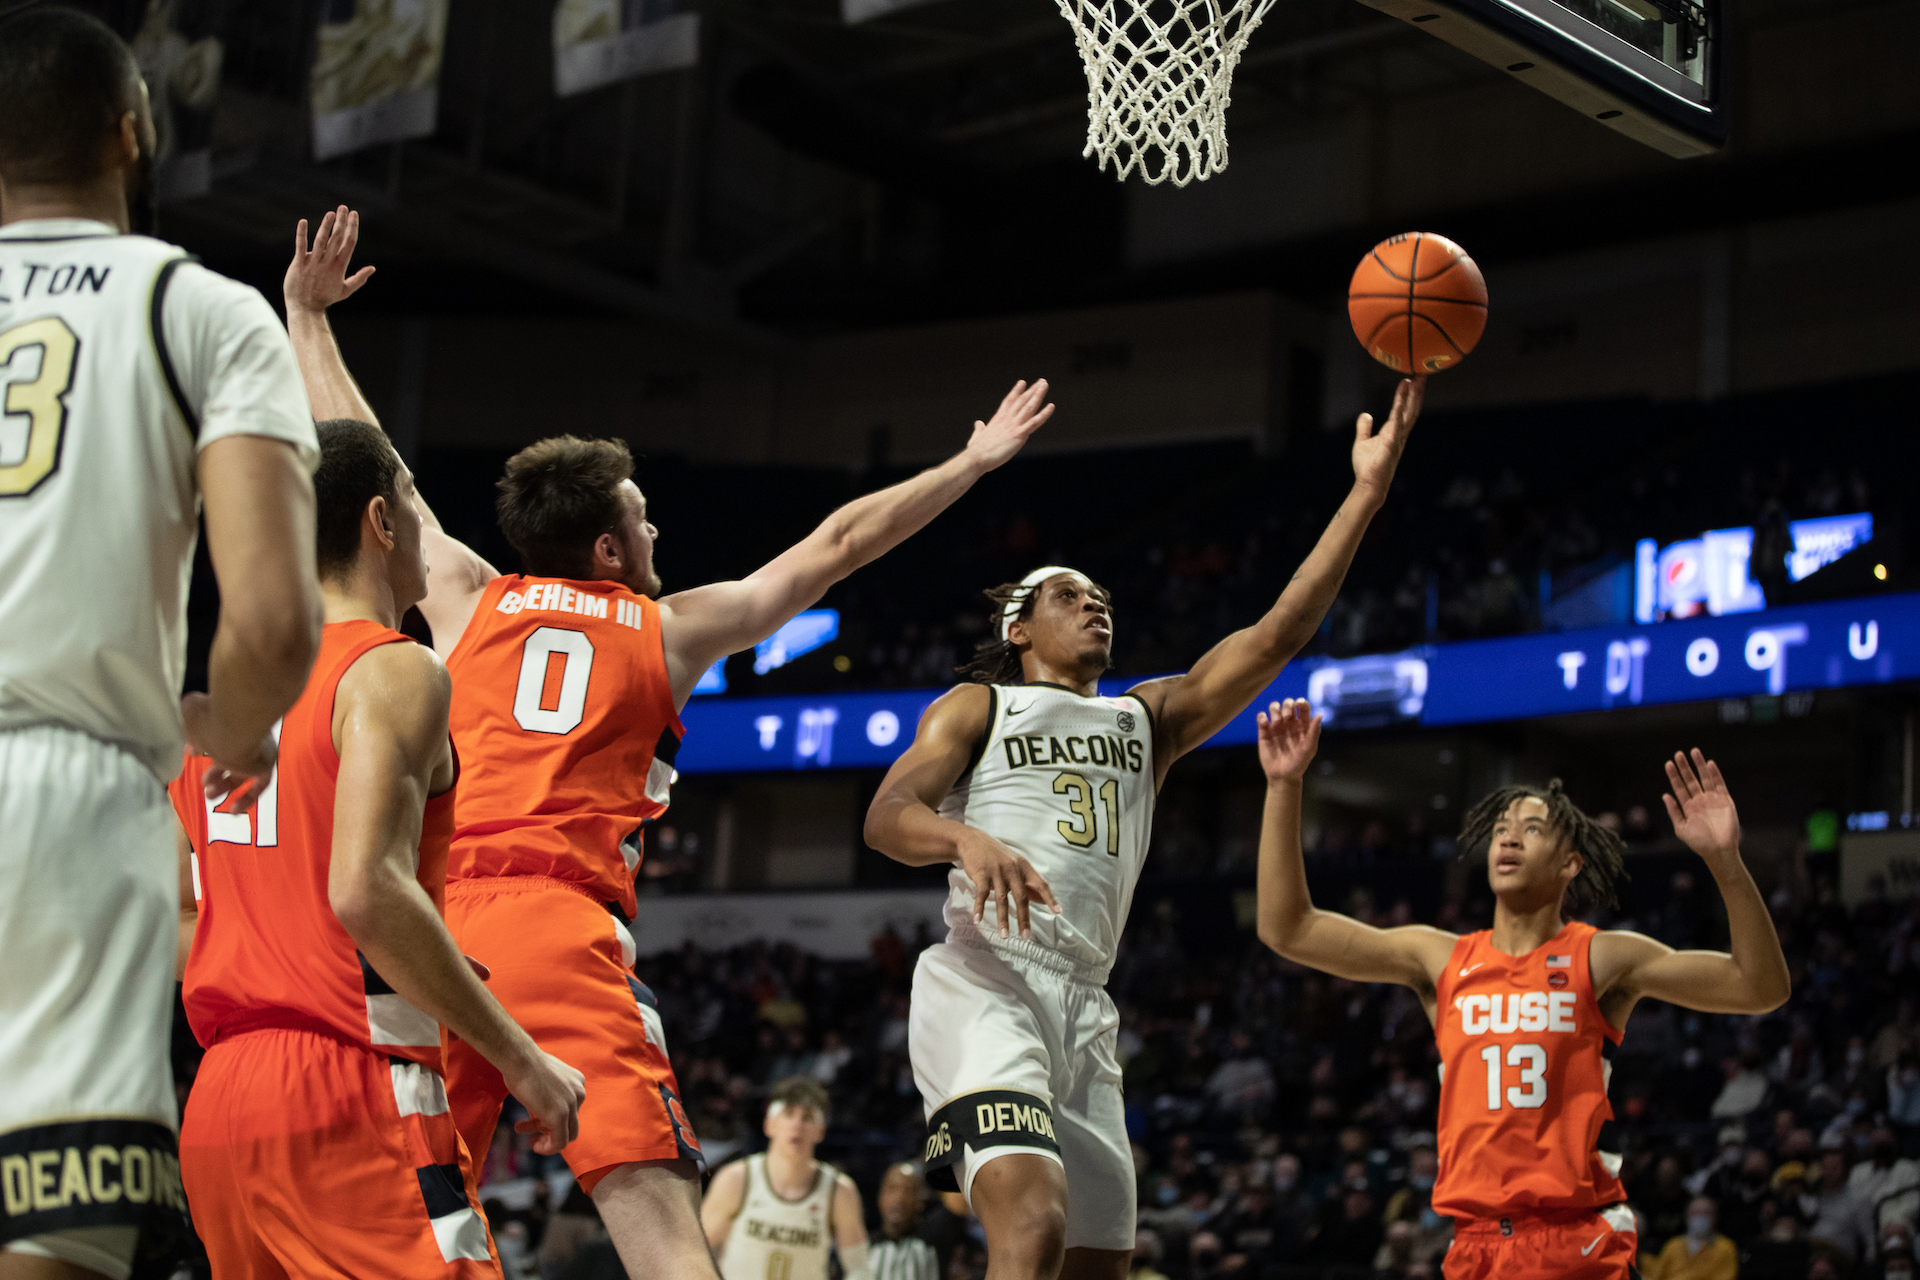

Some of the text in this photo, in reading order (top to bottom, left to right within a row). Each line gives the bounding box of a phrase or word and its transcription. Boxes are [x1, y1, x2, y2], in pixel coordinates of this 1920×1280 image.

[512, 625, 595, 736] 0
[1003, 734, 1144, 775] DEACONS
[1052, 771, 1120, 857] 31
[1481, 1043, 1548, 1111] 13
[976, 1102, 1057, 1143] DEMON
